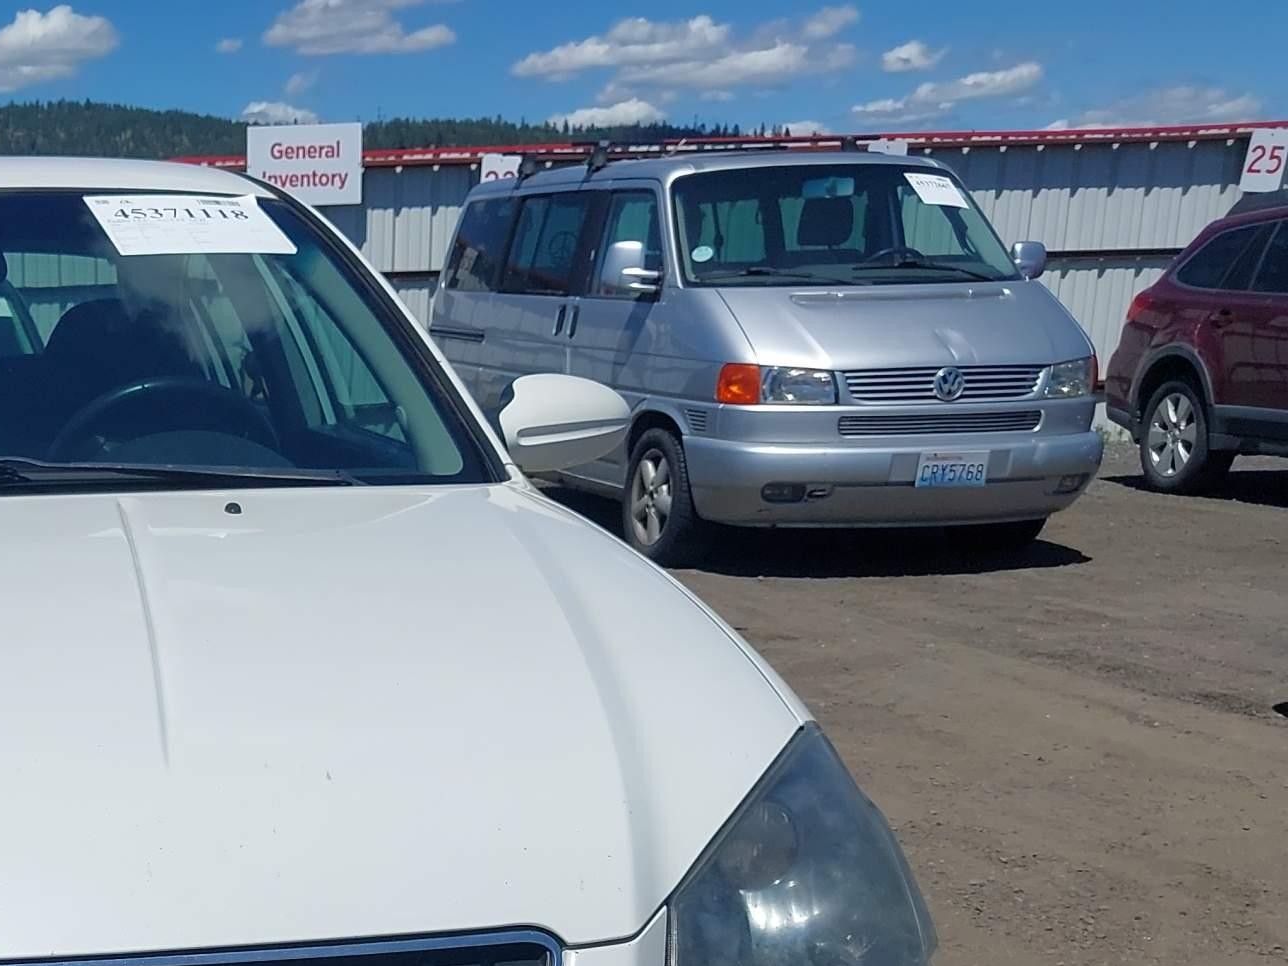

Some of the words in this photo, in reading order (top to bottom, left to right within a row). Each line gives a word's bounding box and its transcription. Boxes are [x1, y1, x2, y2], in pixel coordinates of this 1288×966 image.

[270, 140, 340, 160] General
[1246, 144, 1285, 175] 25
[113, 207, 250, 221] 45371118
[920, 463, 984, 482] CRY5768
